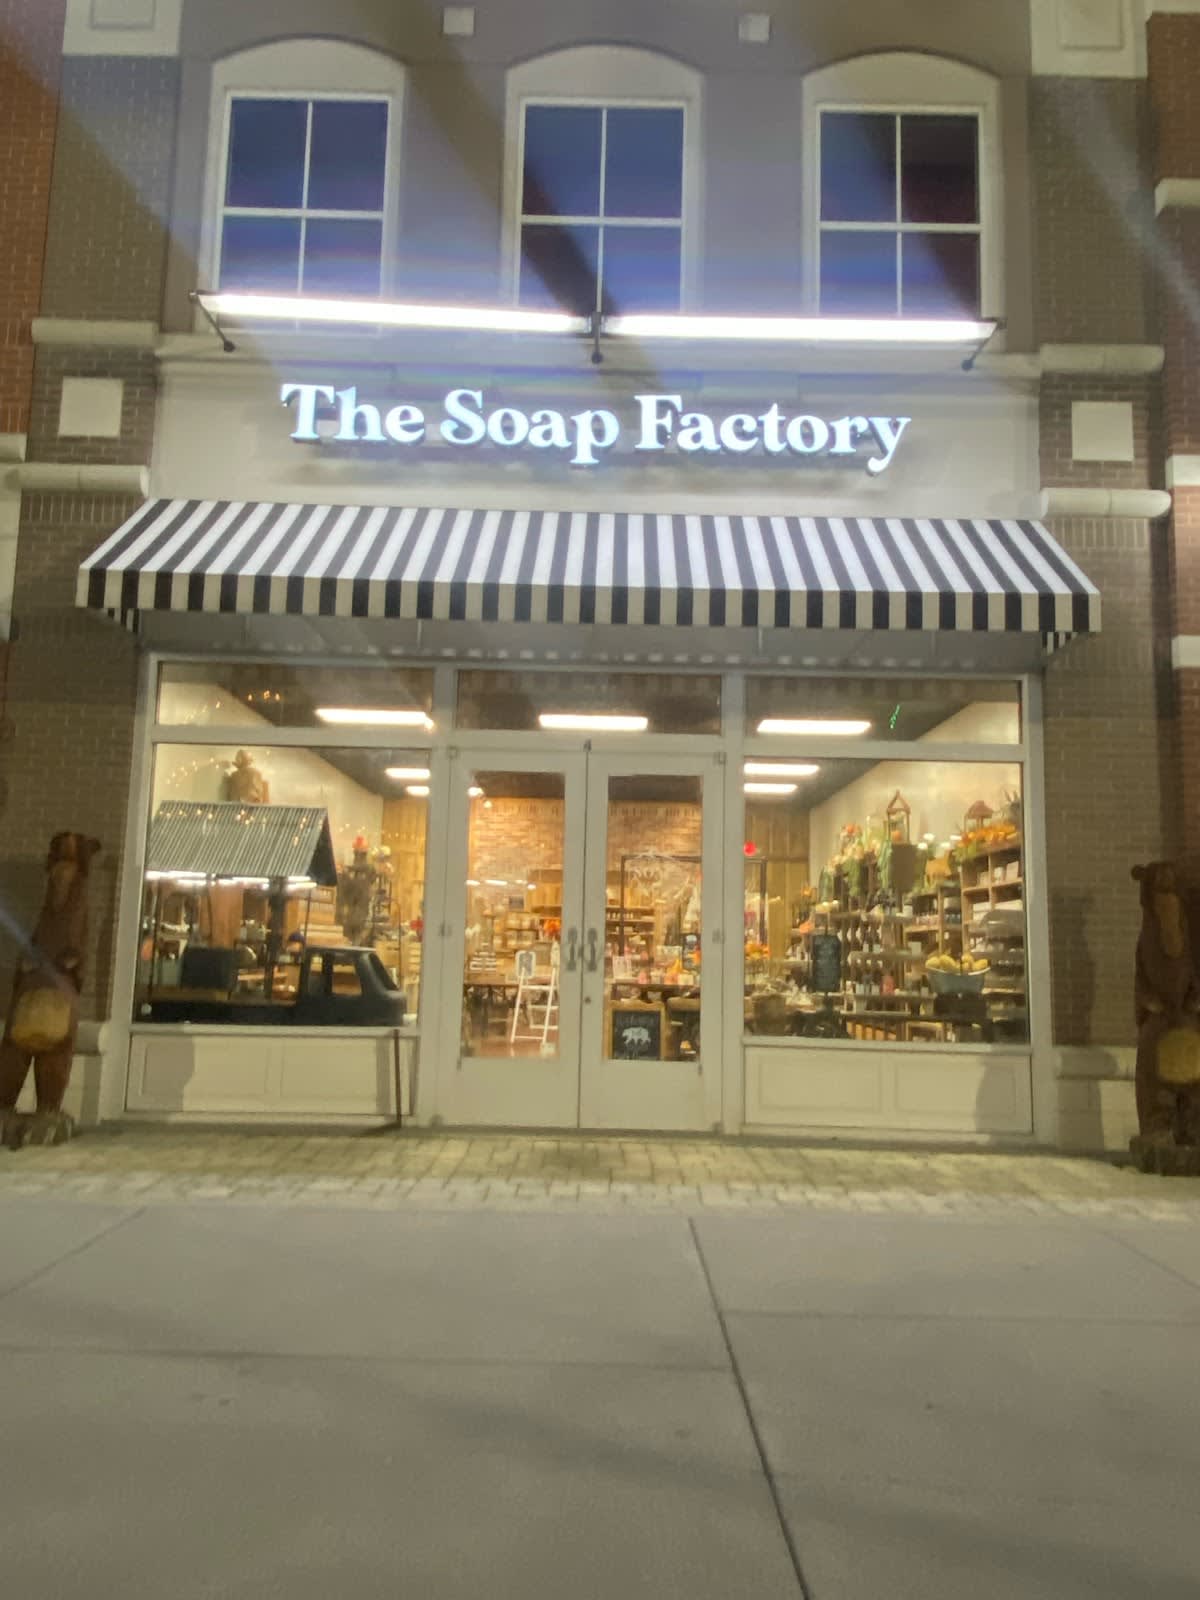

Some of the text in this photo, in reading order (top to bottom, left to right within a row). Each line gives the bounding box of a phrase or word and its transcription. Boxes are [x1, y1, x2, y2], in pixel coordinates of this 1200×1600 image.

[281, 383, 911, 474] The Soap Factory
